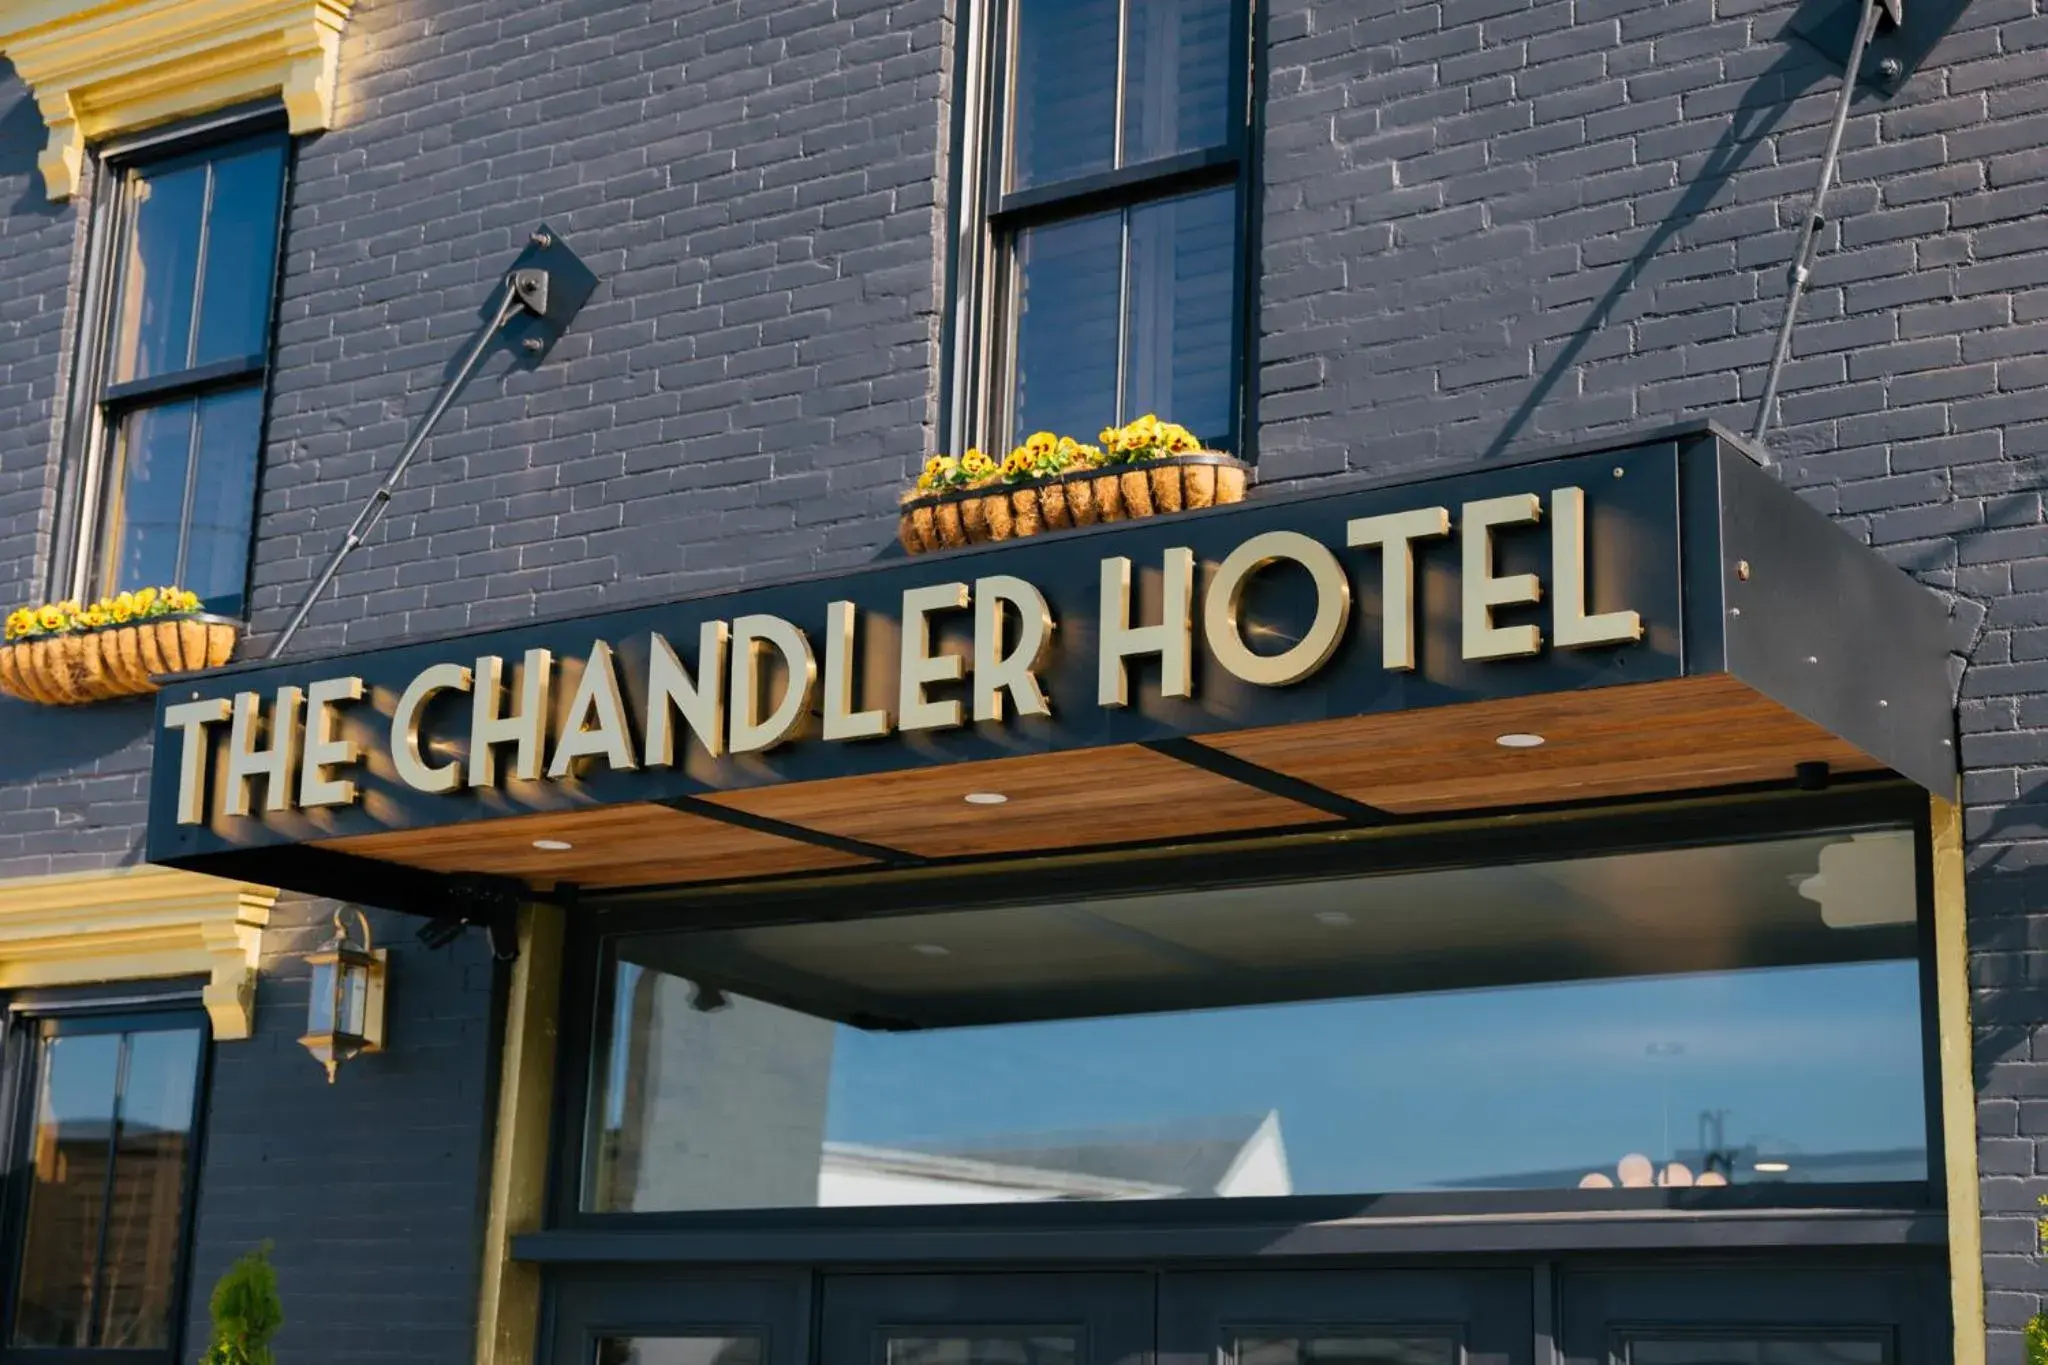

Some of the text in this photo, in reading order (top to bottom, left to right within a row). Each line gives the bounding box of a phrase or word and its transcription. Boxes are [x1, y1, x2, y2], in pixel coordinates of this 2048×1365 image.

[165, 486, 1642, 825] THE CHANDLER HOTEL
